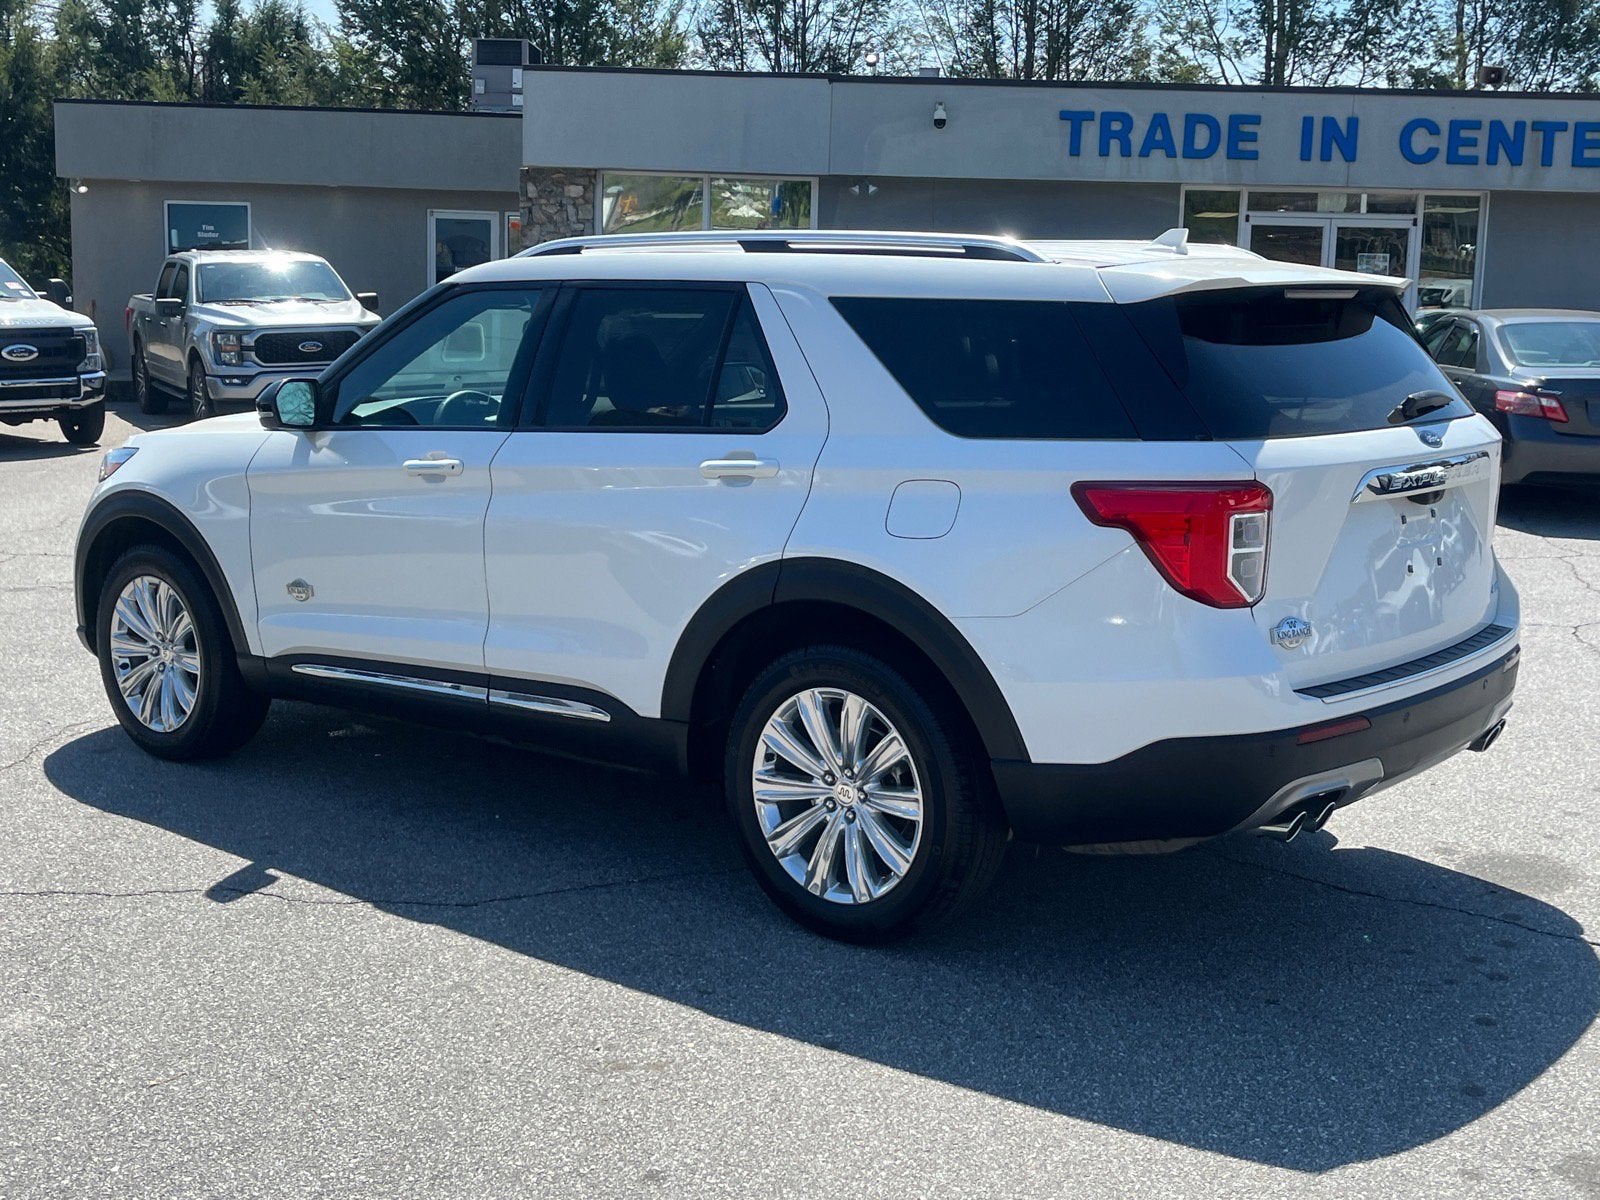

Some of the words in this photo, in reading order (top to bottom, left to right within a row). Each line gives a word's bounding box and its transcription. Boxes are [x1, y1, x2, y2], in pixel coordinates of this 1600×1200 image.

[1059, 110, 1262, 160] TRADE
[1300, 116, 1360, 162] IN
[1399, 118, 1600, 167] CENTE
